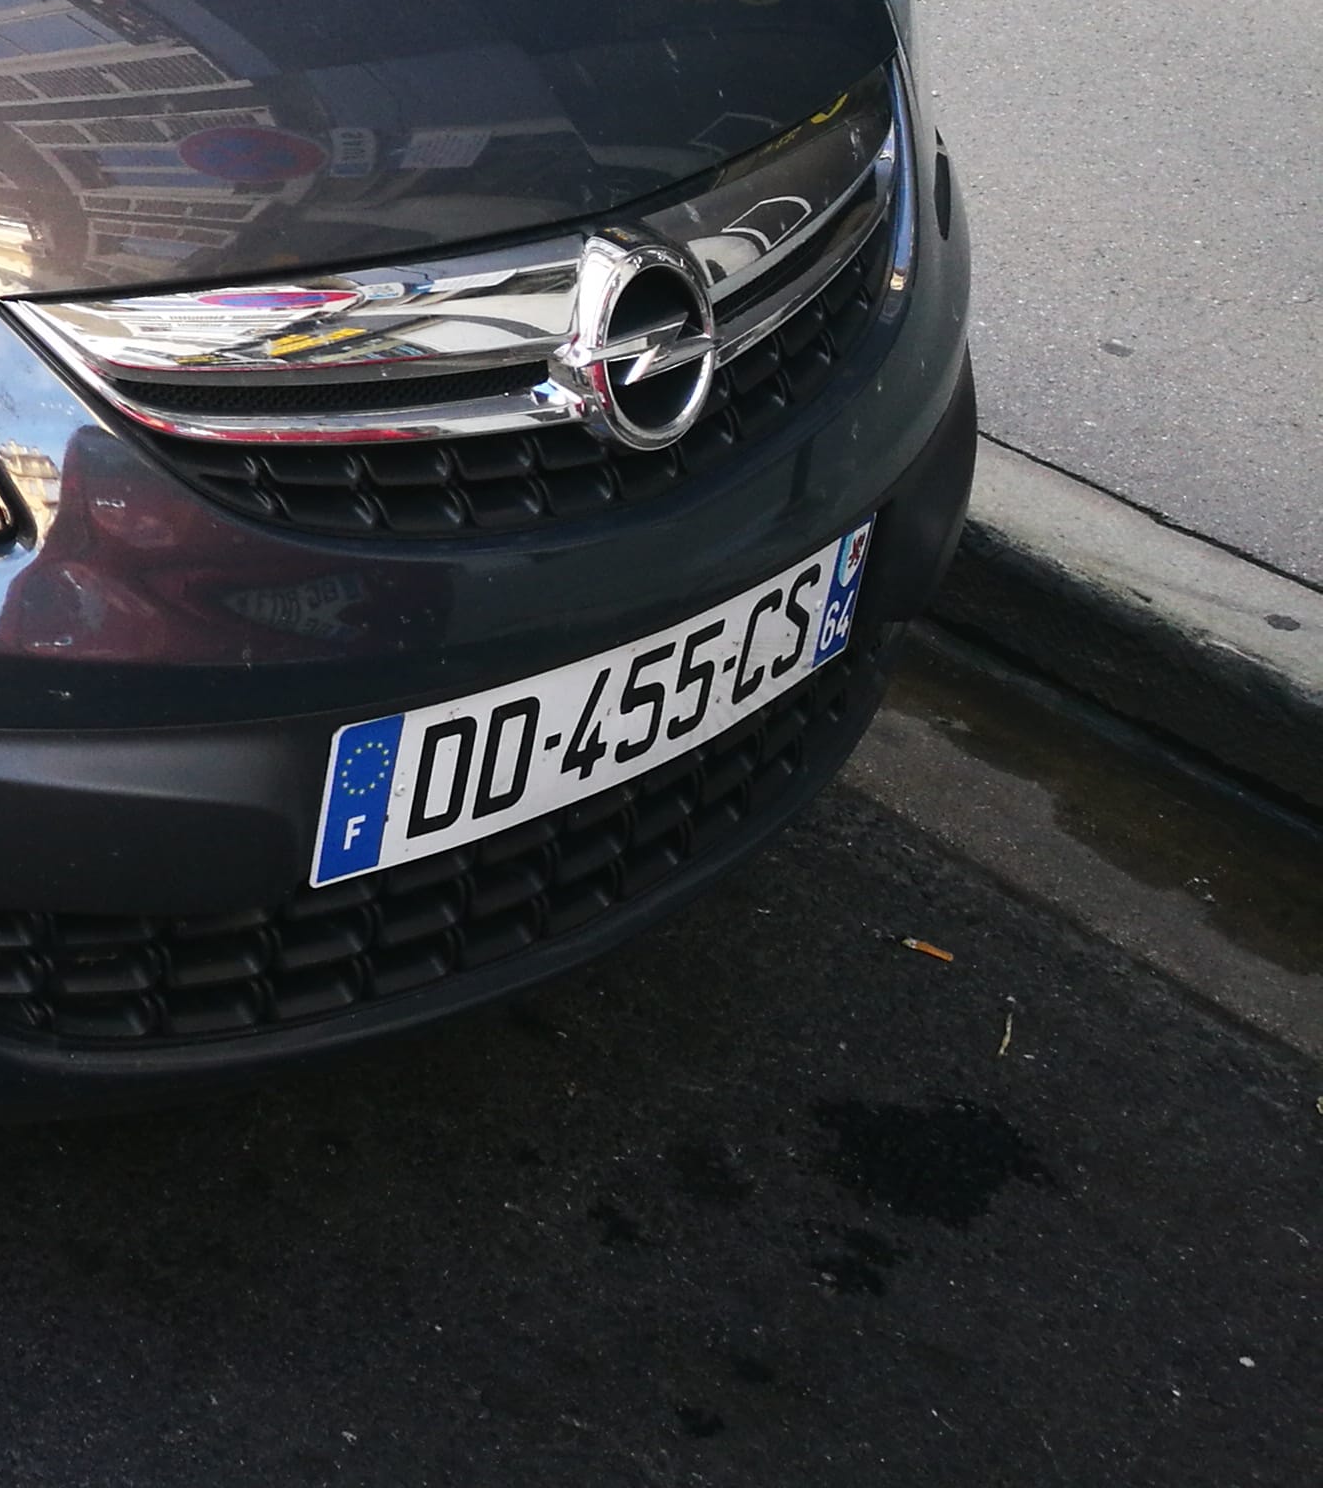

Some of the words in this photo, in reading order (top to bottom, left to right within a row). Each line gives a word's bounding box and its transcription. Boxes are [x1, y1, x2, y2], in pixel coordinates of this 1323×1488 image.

[818, 590, 856, 654] 64
[406, 563, 823, 840] DD-455-CS
[342, 815, 367, 851] F
